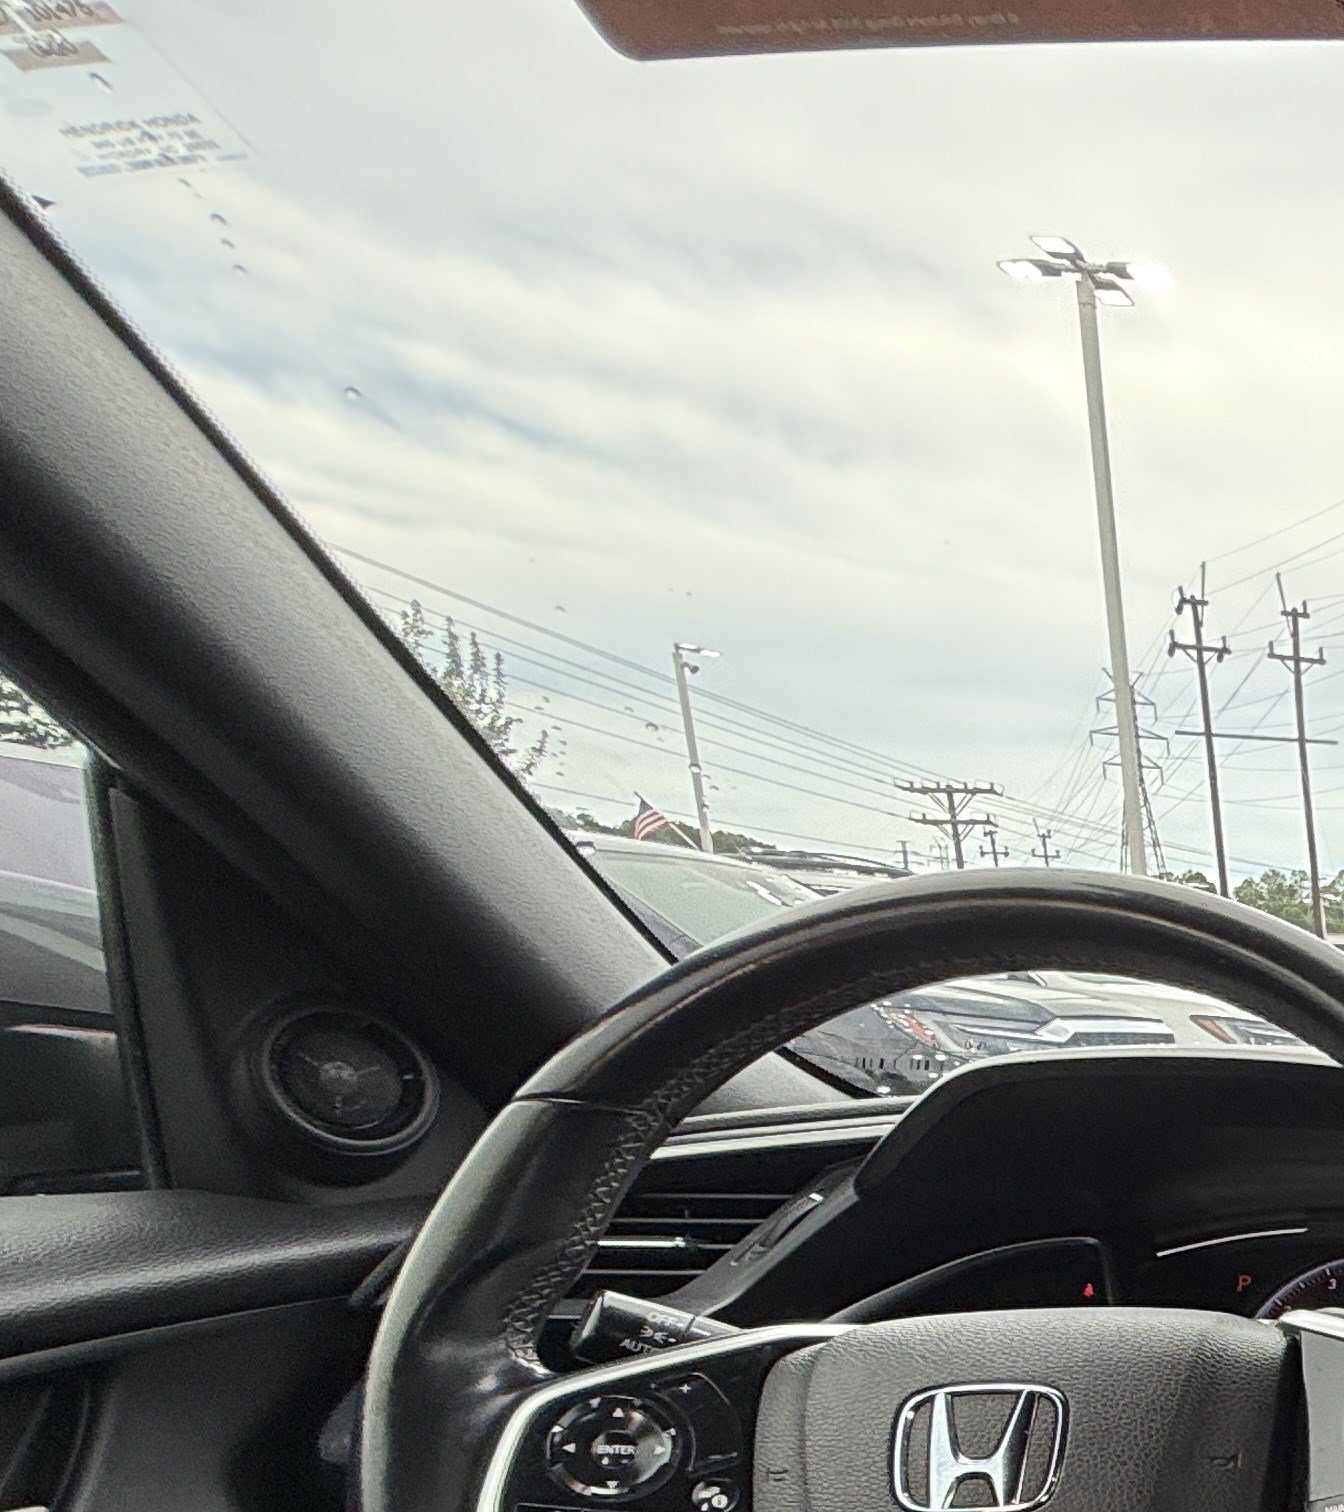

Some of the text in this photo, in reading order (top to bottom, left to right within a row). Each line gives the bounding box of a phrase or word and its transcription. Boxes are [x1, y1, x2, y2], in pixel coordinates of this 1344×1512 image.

[1237, 1275, 1251, 1292] P
[1328, 1278, 1337, 1290] 3
[598, 1446, 635, 1455] ENTER
